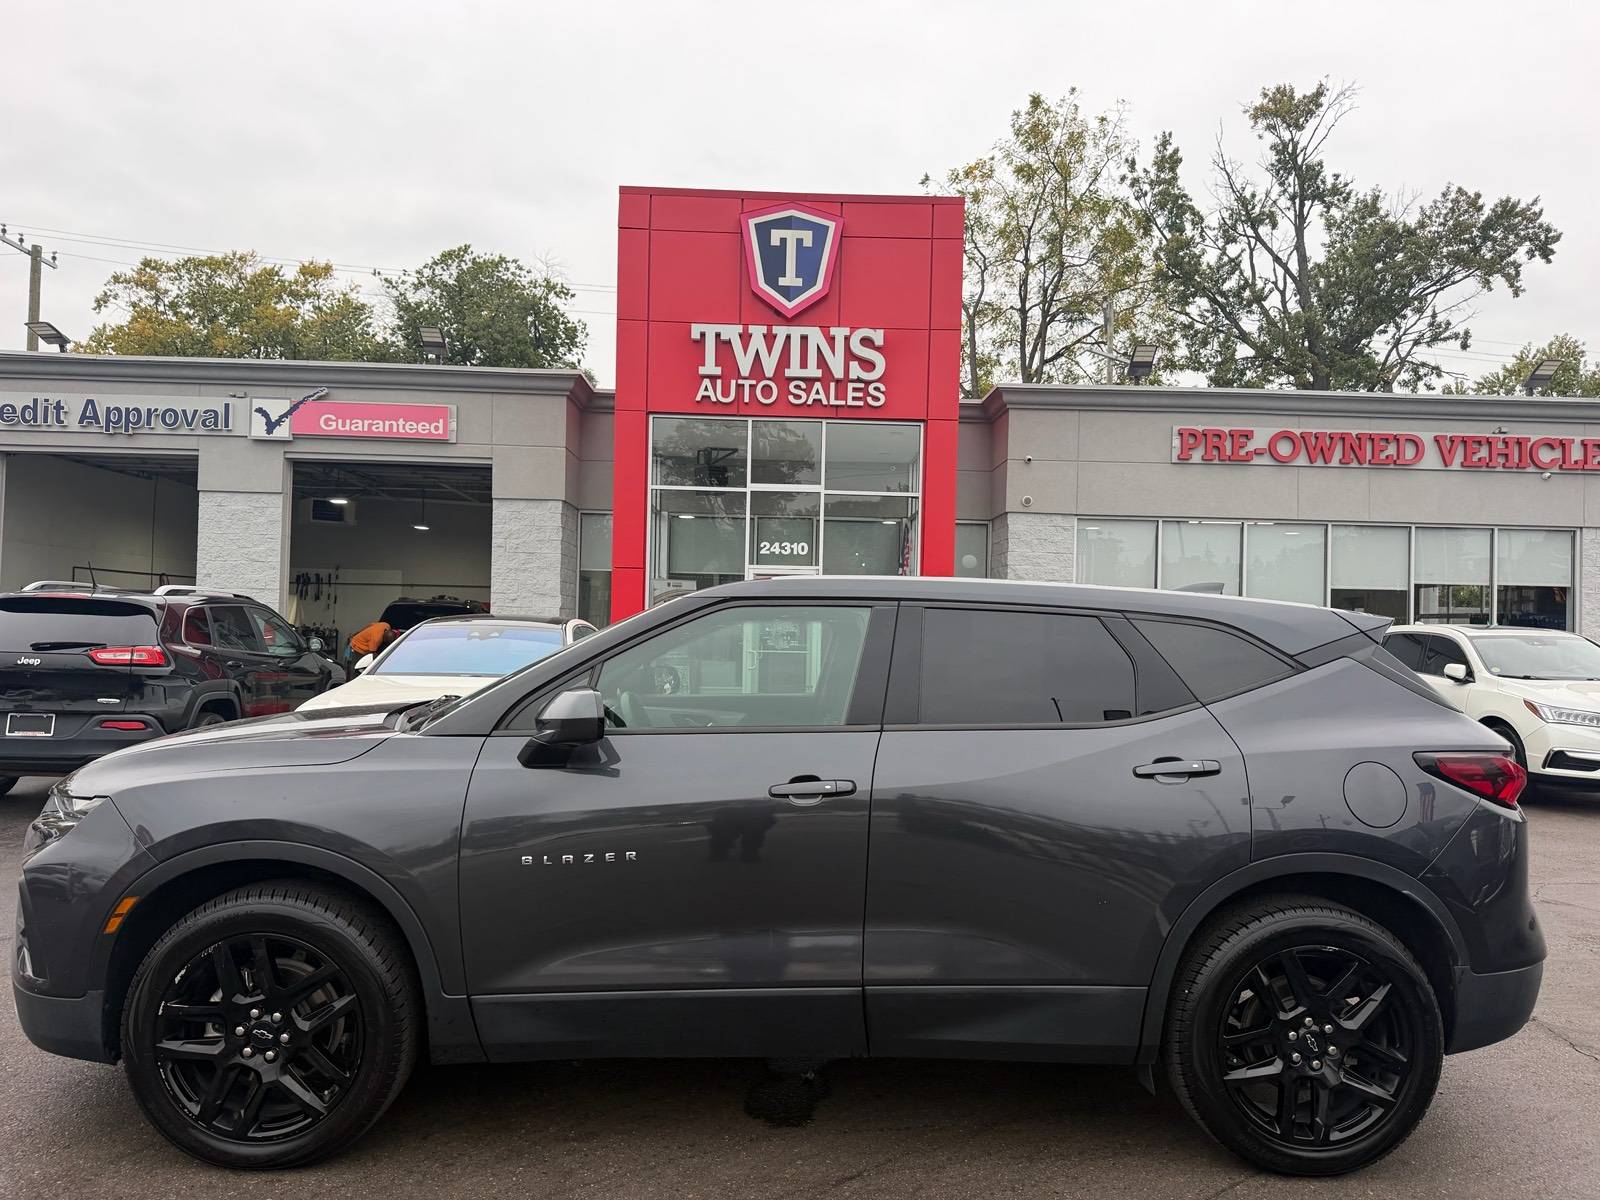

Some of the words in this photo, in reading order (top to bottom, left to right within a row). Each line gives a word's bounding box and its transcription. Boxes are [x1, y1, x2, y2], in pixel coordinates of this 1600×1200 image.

[770, 228, 813, 287] T
[690, 323, 886, 382] TWINS
[695, 379, 778, 405] AUTO
[787, 380, 886, 408] SALES
[77, 398, 232, 435] Approval
[318, 413, 445, 436] Guaranteed
[1177, 427, 1425, 466] PRE-OWNED
[1433, 434, 1600, 471] VEHICLE
[759, 540, 809, 557] 24310
[17, 656, 41, 666] Jeep
[521, 851, 637, 865] BLAZER
